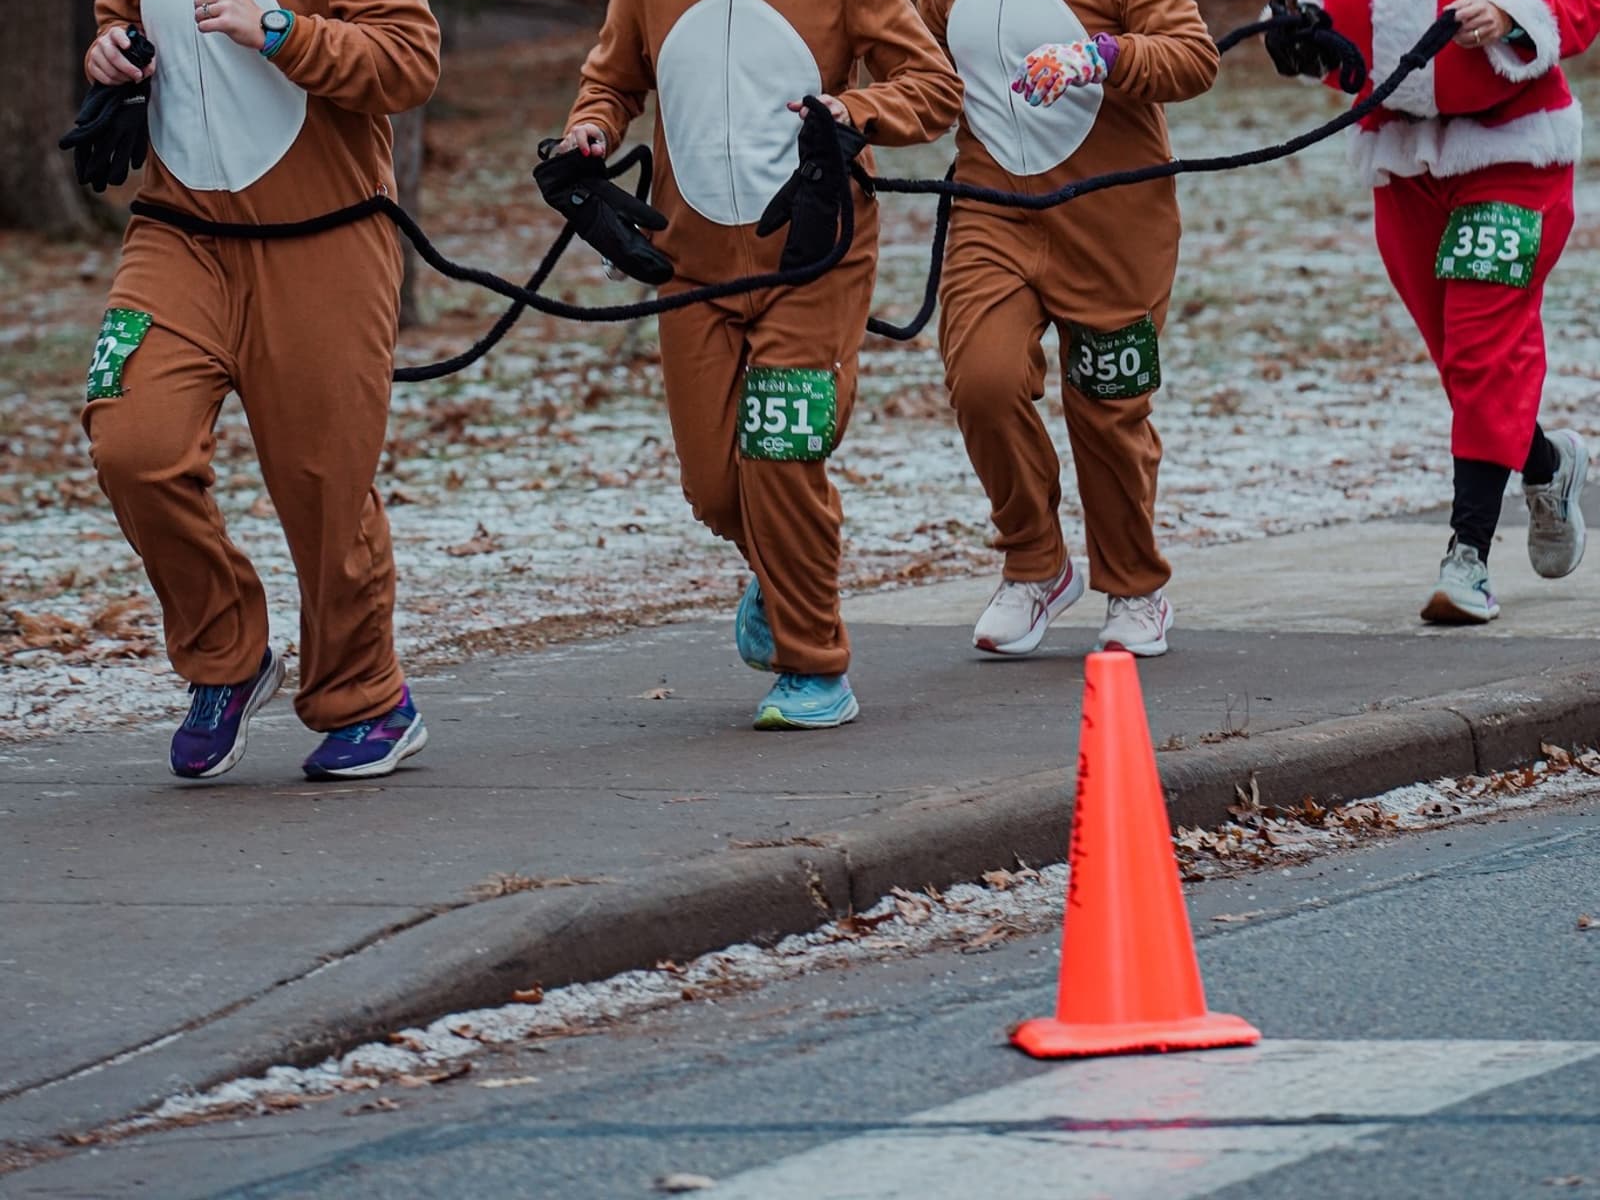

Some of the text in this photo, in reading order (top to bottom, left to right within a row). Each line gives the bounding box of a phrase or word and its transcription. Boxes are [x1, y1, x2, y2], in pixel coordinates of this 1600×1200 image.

[1452, 225, 1520, 261] 353
[1078, 344, 1141, 381] 350
[744, 395, 814, 435] 351
